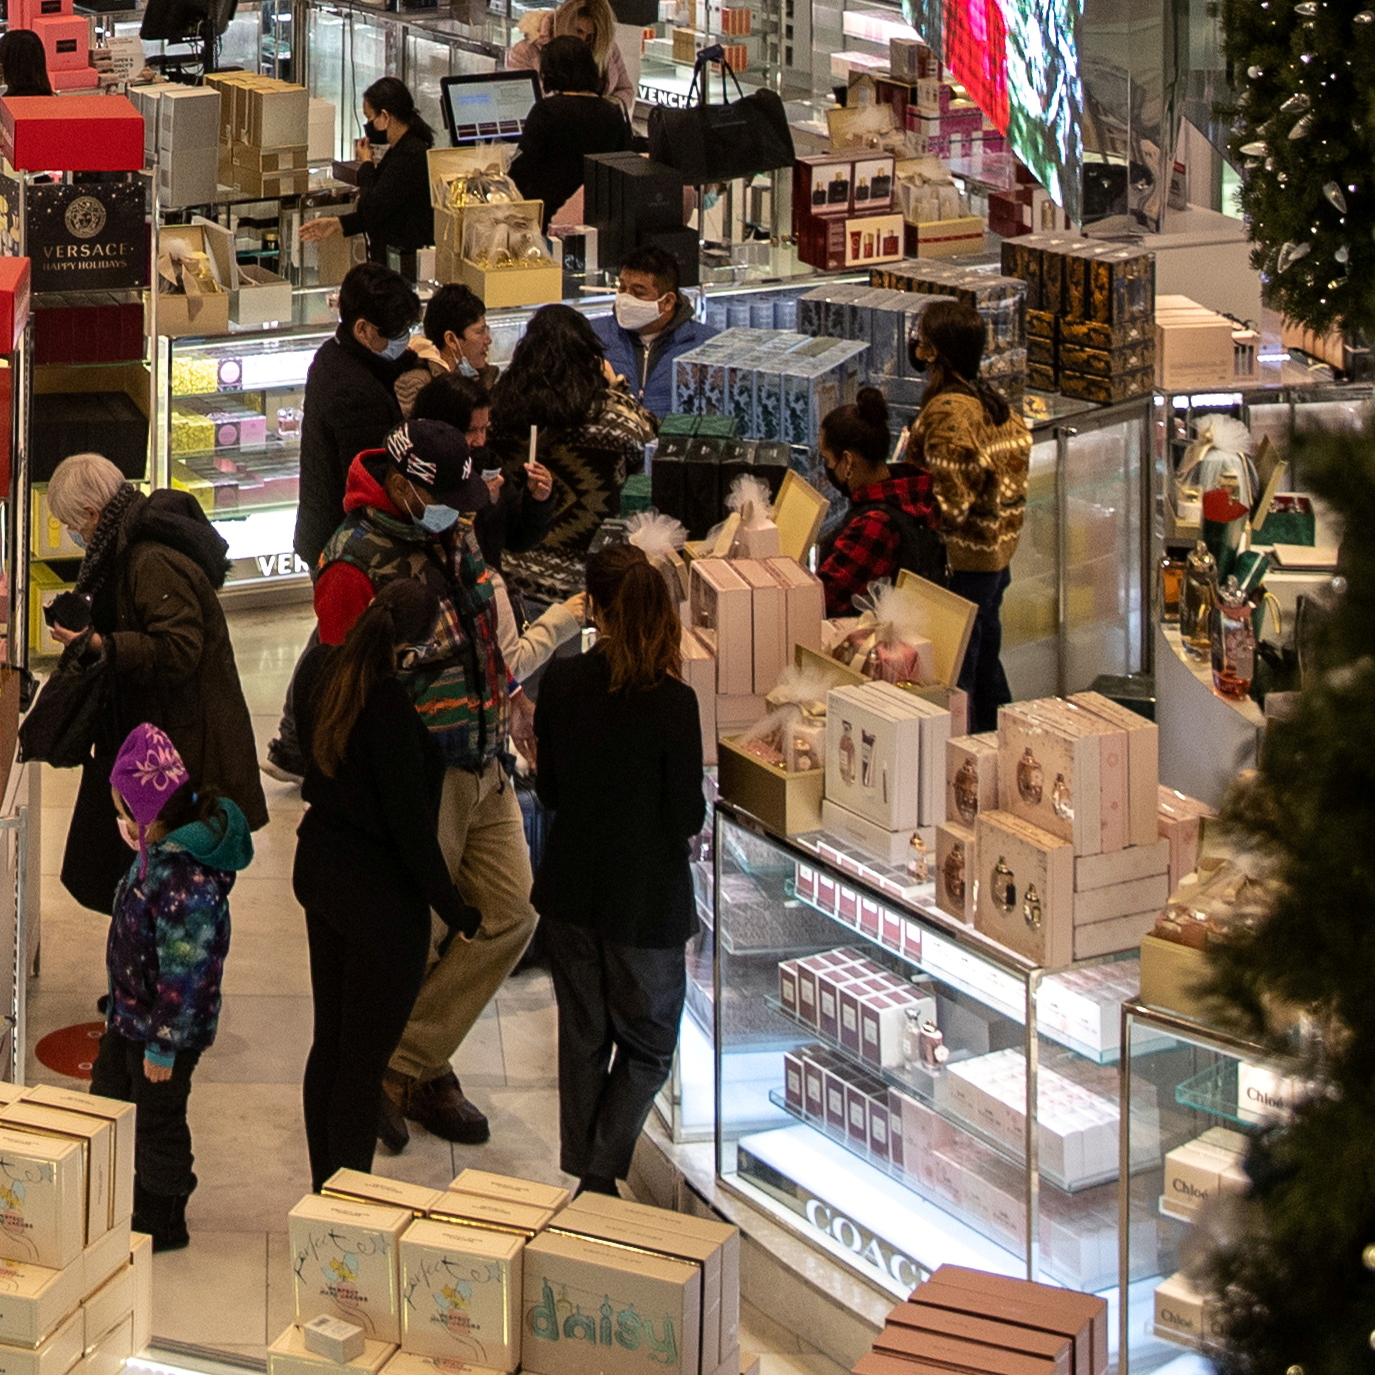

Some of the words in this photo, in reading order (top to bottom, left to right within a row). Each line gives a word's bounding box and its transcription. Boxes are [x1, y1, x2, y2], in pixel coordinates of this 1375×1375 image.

[43, 243, 129, 258] VERSACE
[43, 260, 75, 271] HAPPY
[78, 259, 128, 270] HOLIDAYS
[529, 1279, 678, 1365] daisy
